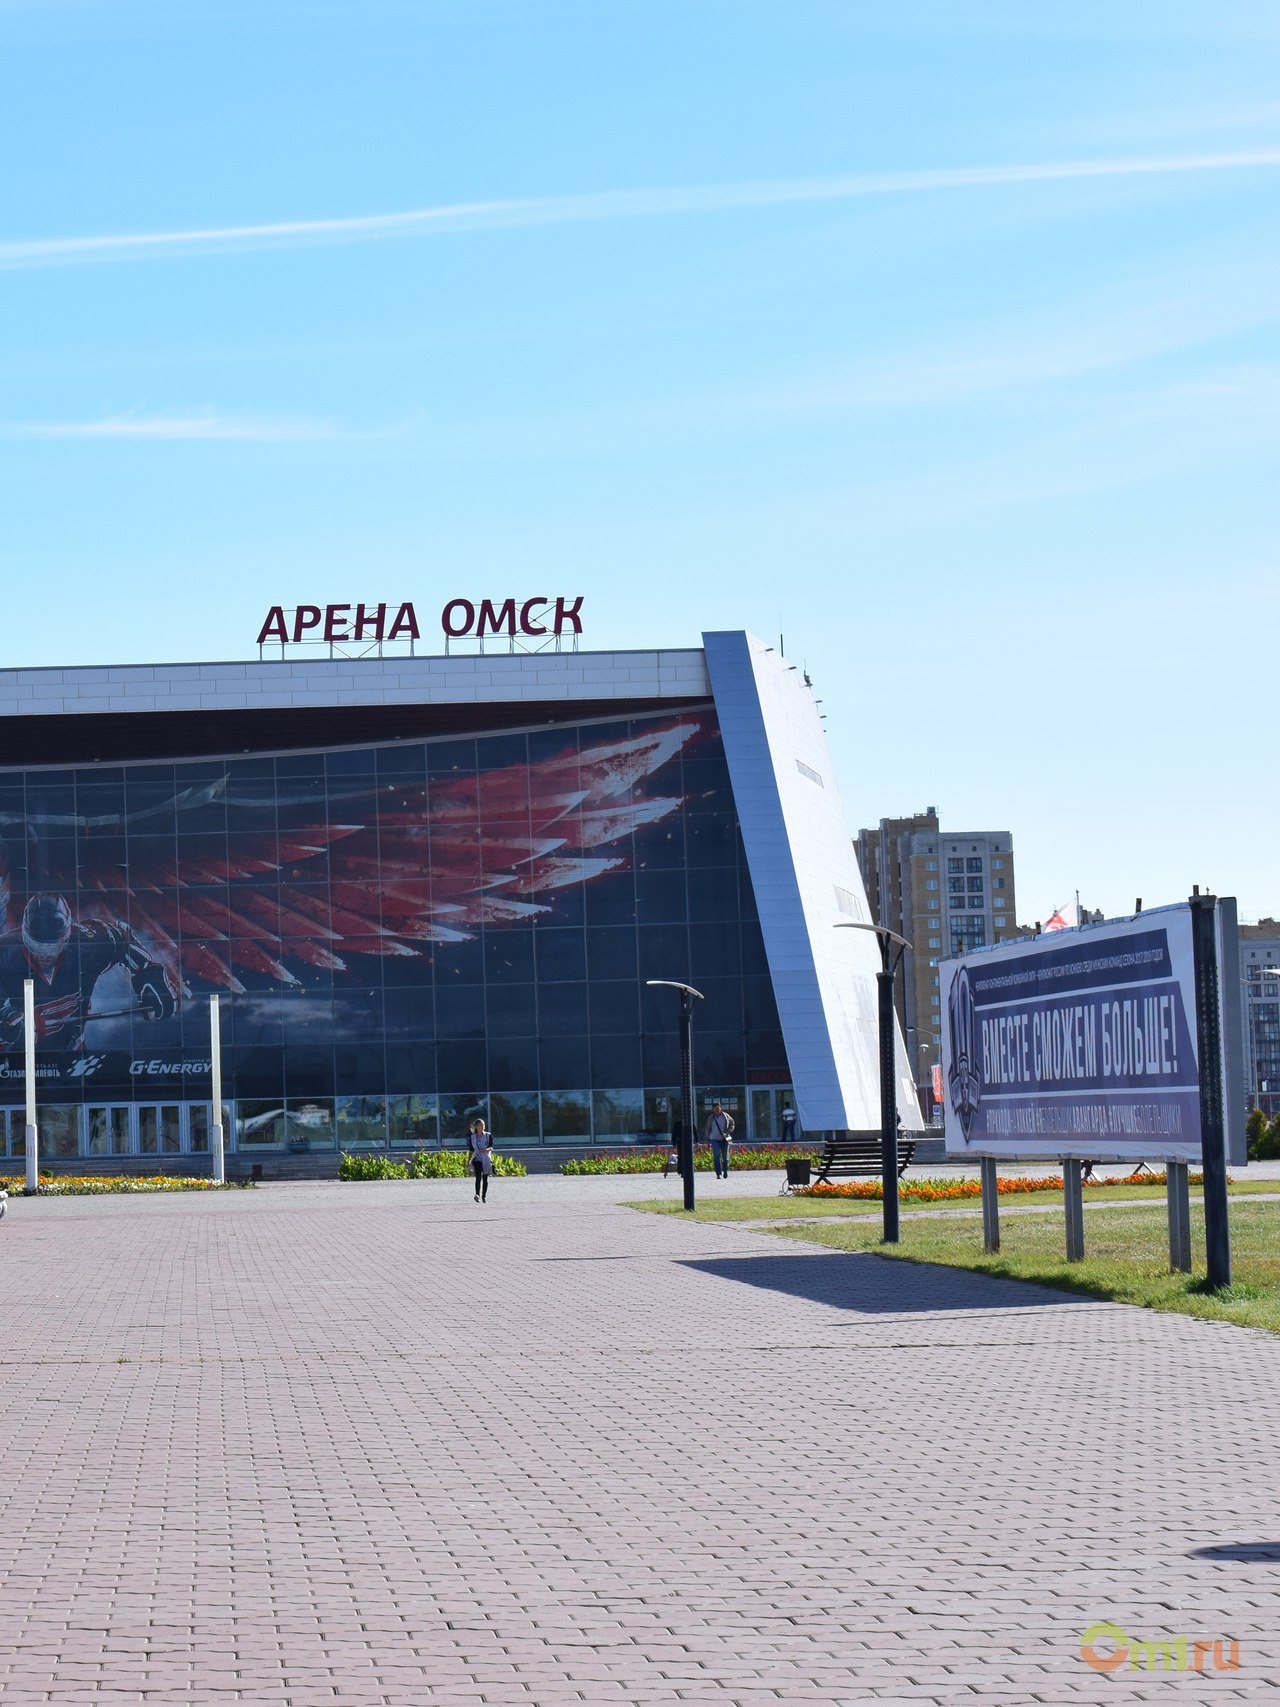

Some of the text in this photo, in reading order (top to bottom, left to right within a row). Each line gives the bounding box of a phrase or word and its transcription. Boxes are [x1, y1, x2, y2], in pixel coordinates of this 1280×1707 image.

[256, 596, 584, 643] АРЕНА ОМСК
[982, 995, 1178, 1084] ВМЕСТЕ СМОЖЕМ БОЛЬШЕ!
